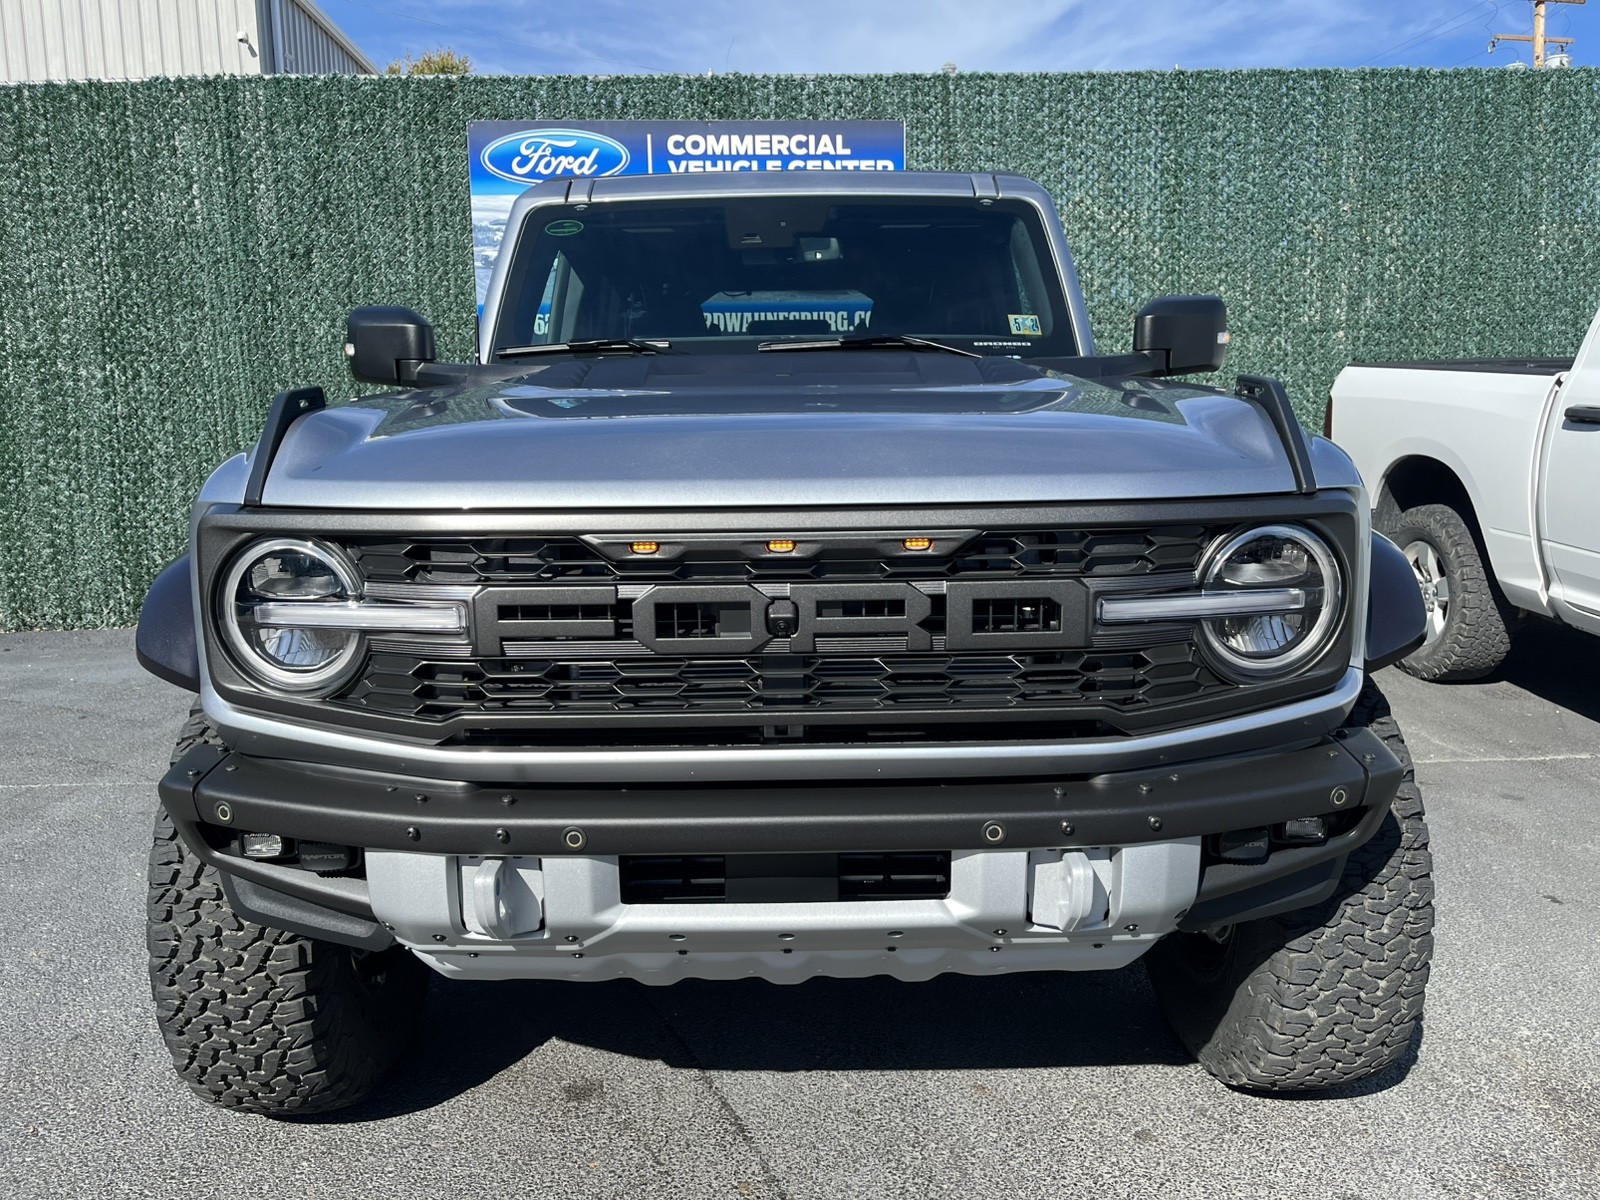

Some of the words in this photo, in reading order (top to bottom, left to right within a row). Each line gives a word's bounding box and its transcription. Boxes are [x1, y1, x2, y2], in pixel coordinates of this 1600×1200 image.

[511, 137, 600, 175] Ford
[666, 134, 852, 156] COMMERCIAL
[473, 580, 1089, 655] FORD
